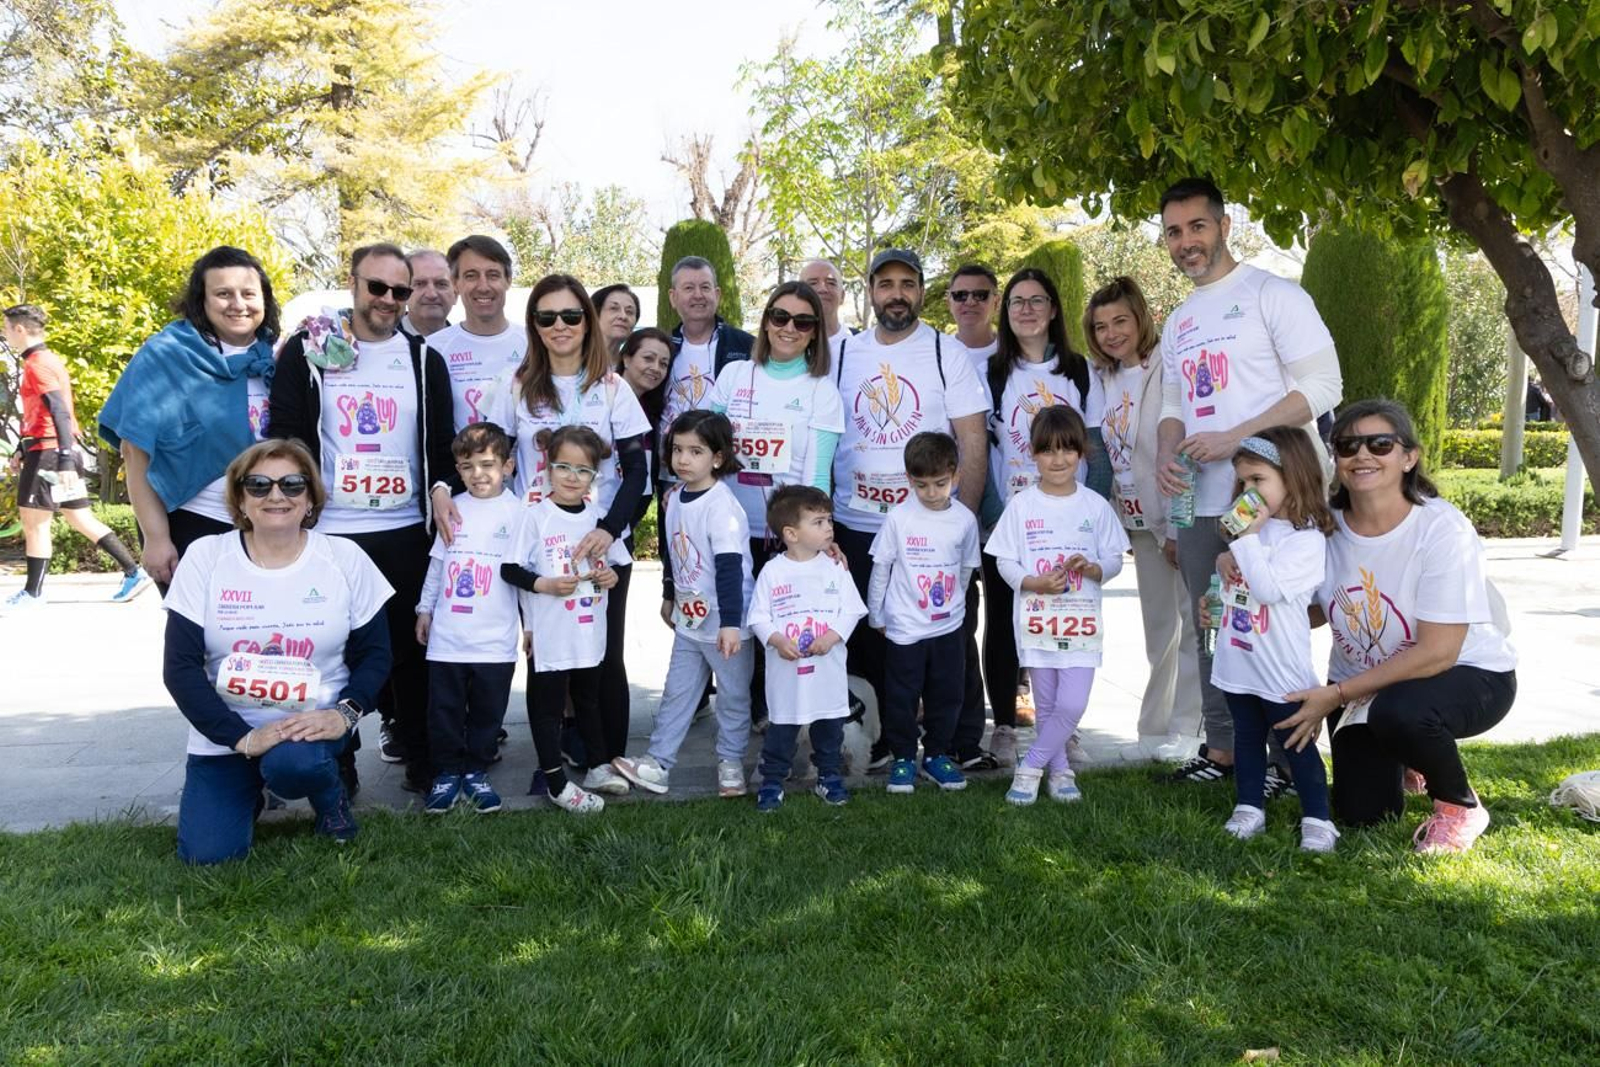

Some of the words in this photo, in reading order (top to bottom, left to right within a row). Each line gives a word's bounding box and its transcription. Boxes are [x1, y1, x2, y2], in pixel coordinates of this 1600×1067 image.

[342, 475, 406, 494] 5128
[857, 482, 910, 504] 5262
[219, 588, 253, 603] XXVII
[1028, 616, 1097, 636] 5125
[227, 677, 308, 702] 5501
